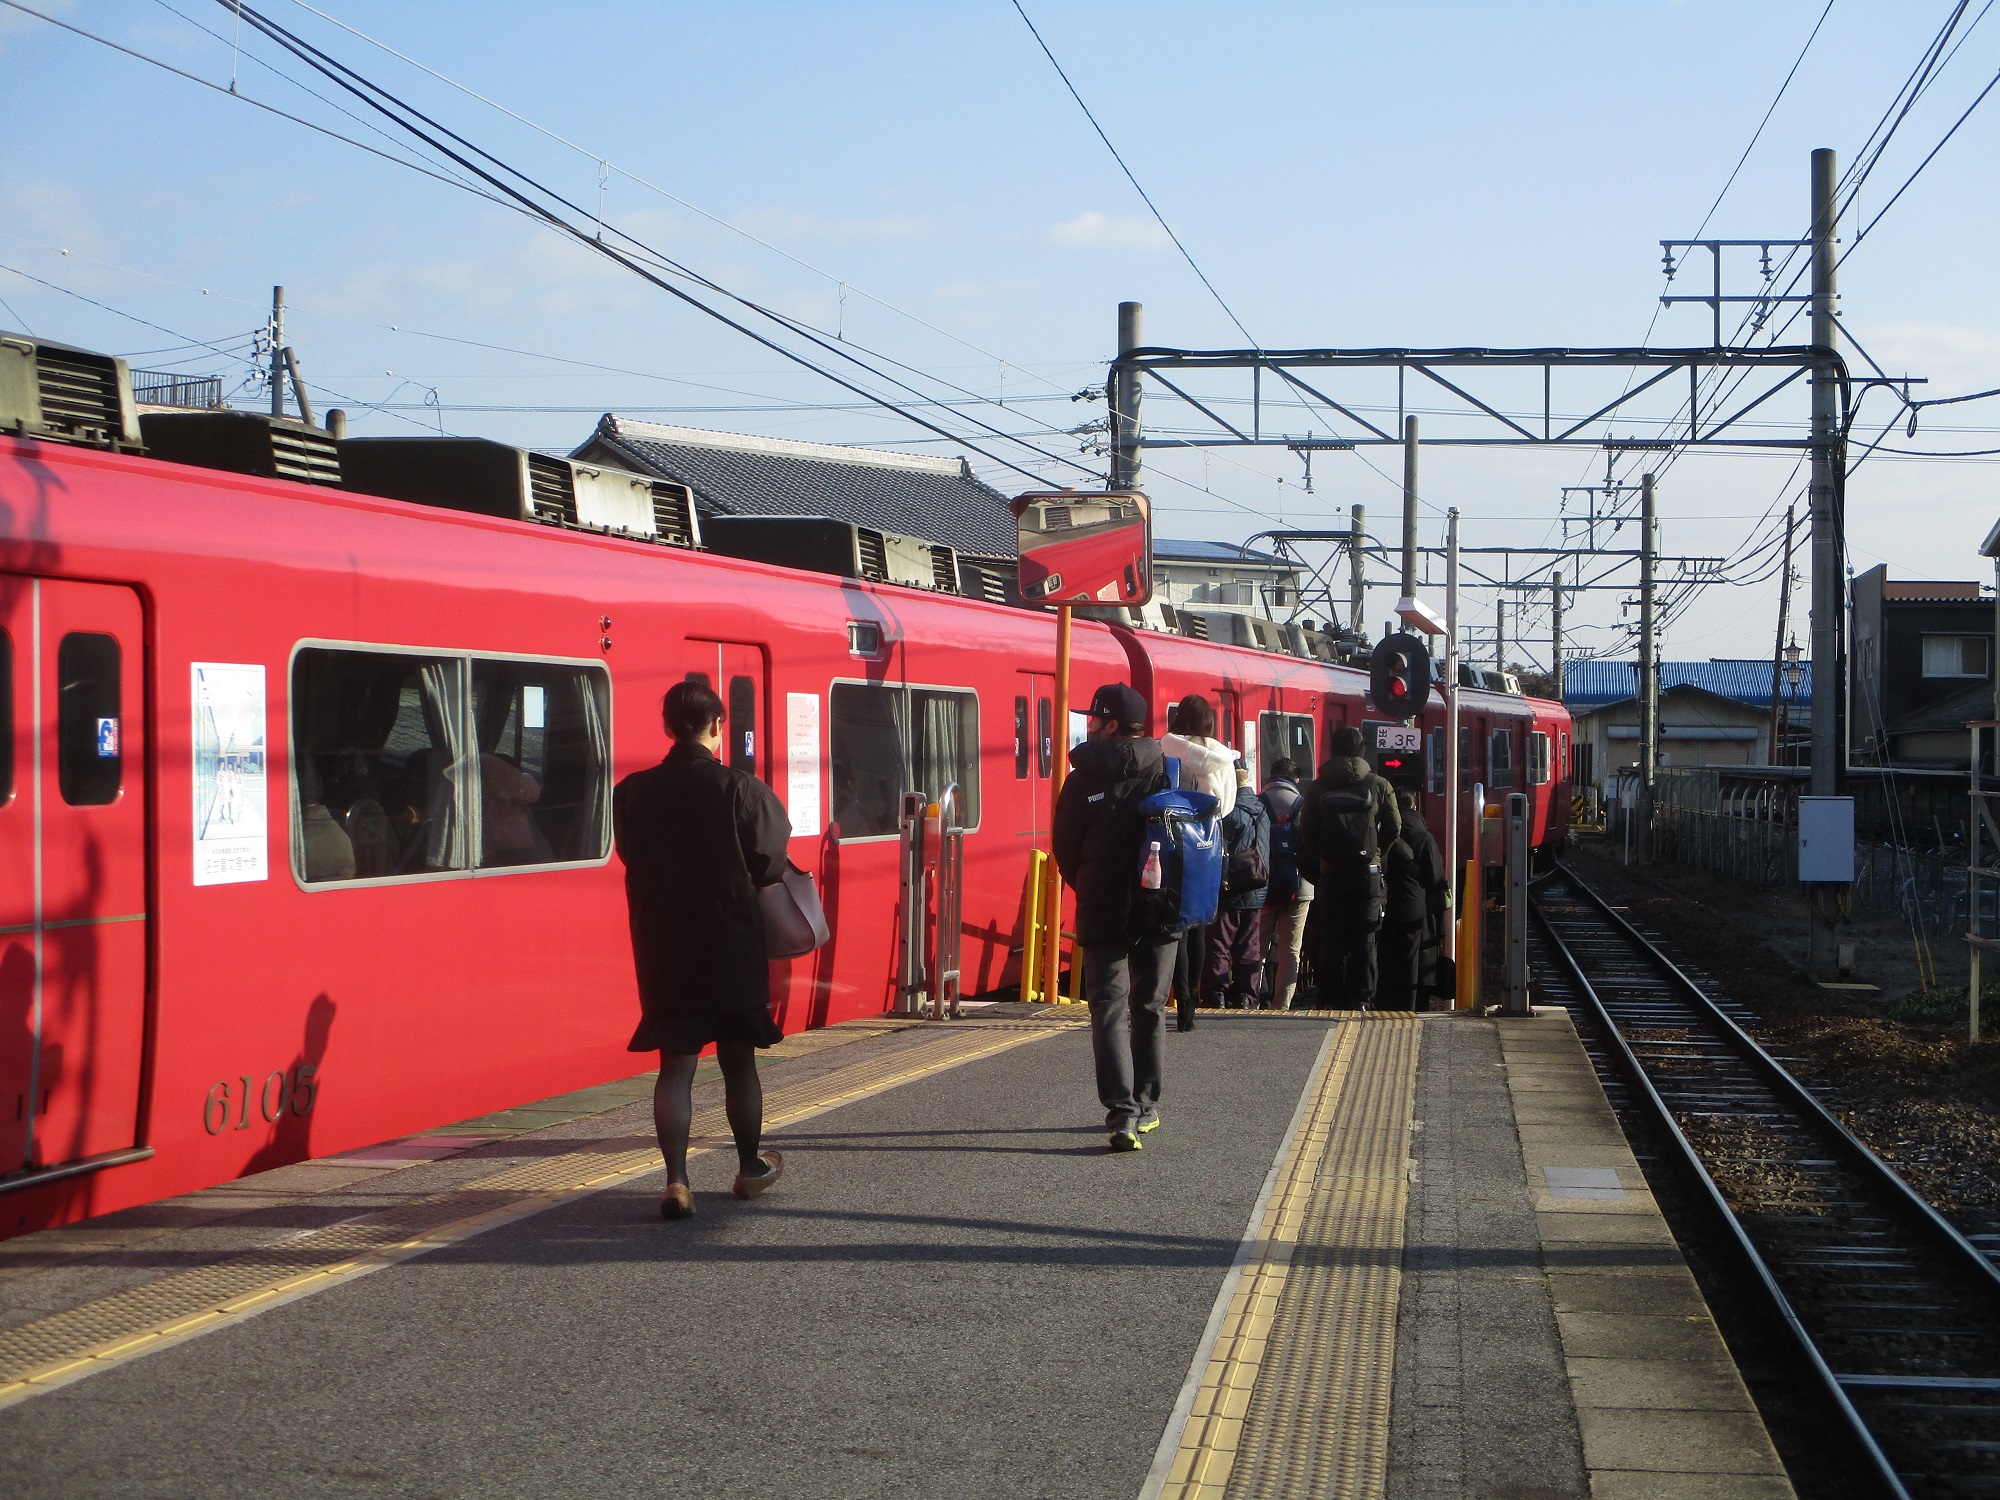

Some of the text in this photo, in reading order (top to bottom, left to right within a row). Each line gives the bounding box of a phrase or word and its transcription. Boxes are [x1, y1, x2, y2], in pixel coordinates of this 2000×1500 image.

[1378, 729, 1388, 748] 出発
[1394, 734, 1416, 747] 3R
[204, 1064, 318, 1136] 6105
